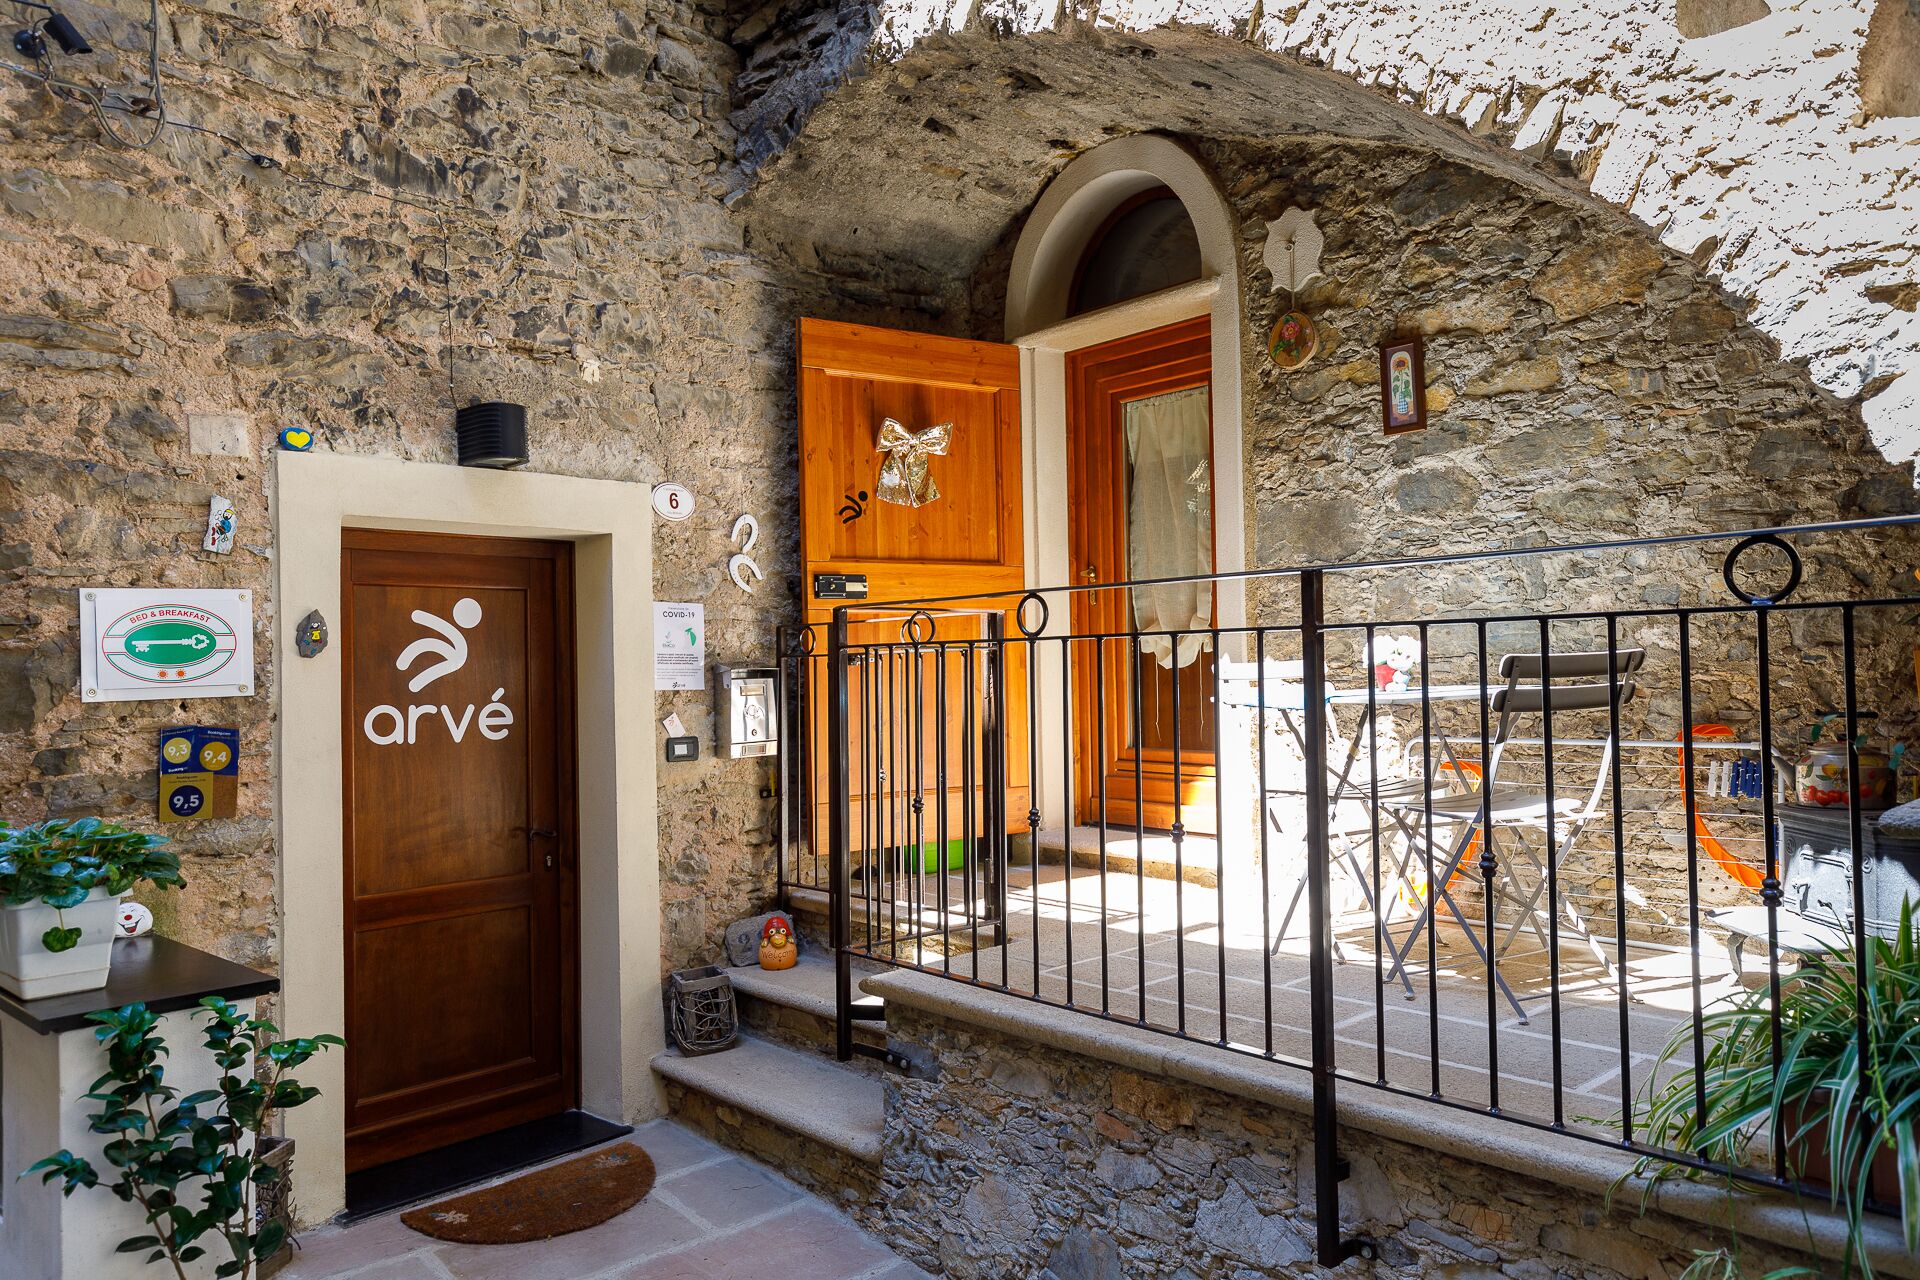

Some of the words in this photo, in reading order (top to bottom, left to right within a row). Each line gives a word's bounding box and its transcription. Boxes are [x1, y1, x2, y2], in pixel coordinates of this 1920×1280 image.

[669, 492, 679, 509] 6
[129, 612, 148, 624] BED
[150, 610, 157, 618] &
[158, 609, 212, 623] BREAKFAST
[662, 610, 695, 618] COVID-19
[364, 687, 513, 745] arvé
[168, 744, 188, 757] 9,3
[203, 750, 227, 764] 9,4
[173, 794, 200, 809] 9,5
[761, 950, 795, 960] Welcom
